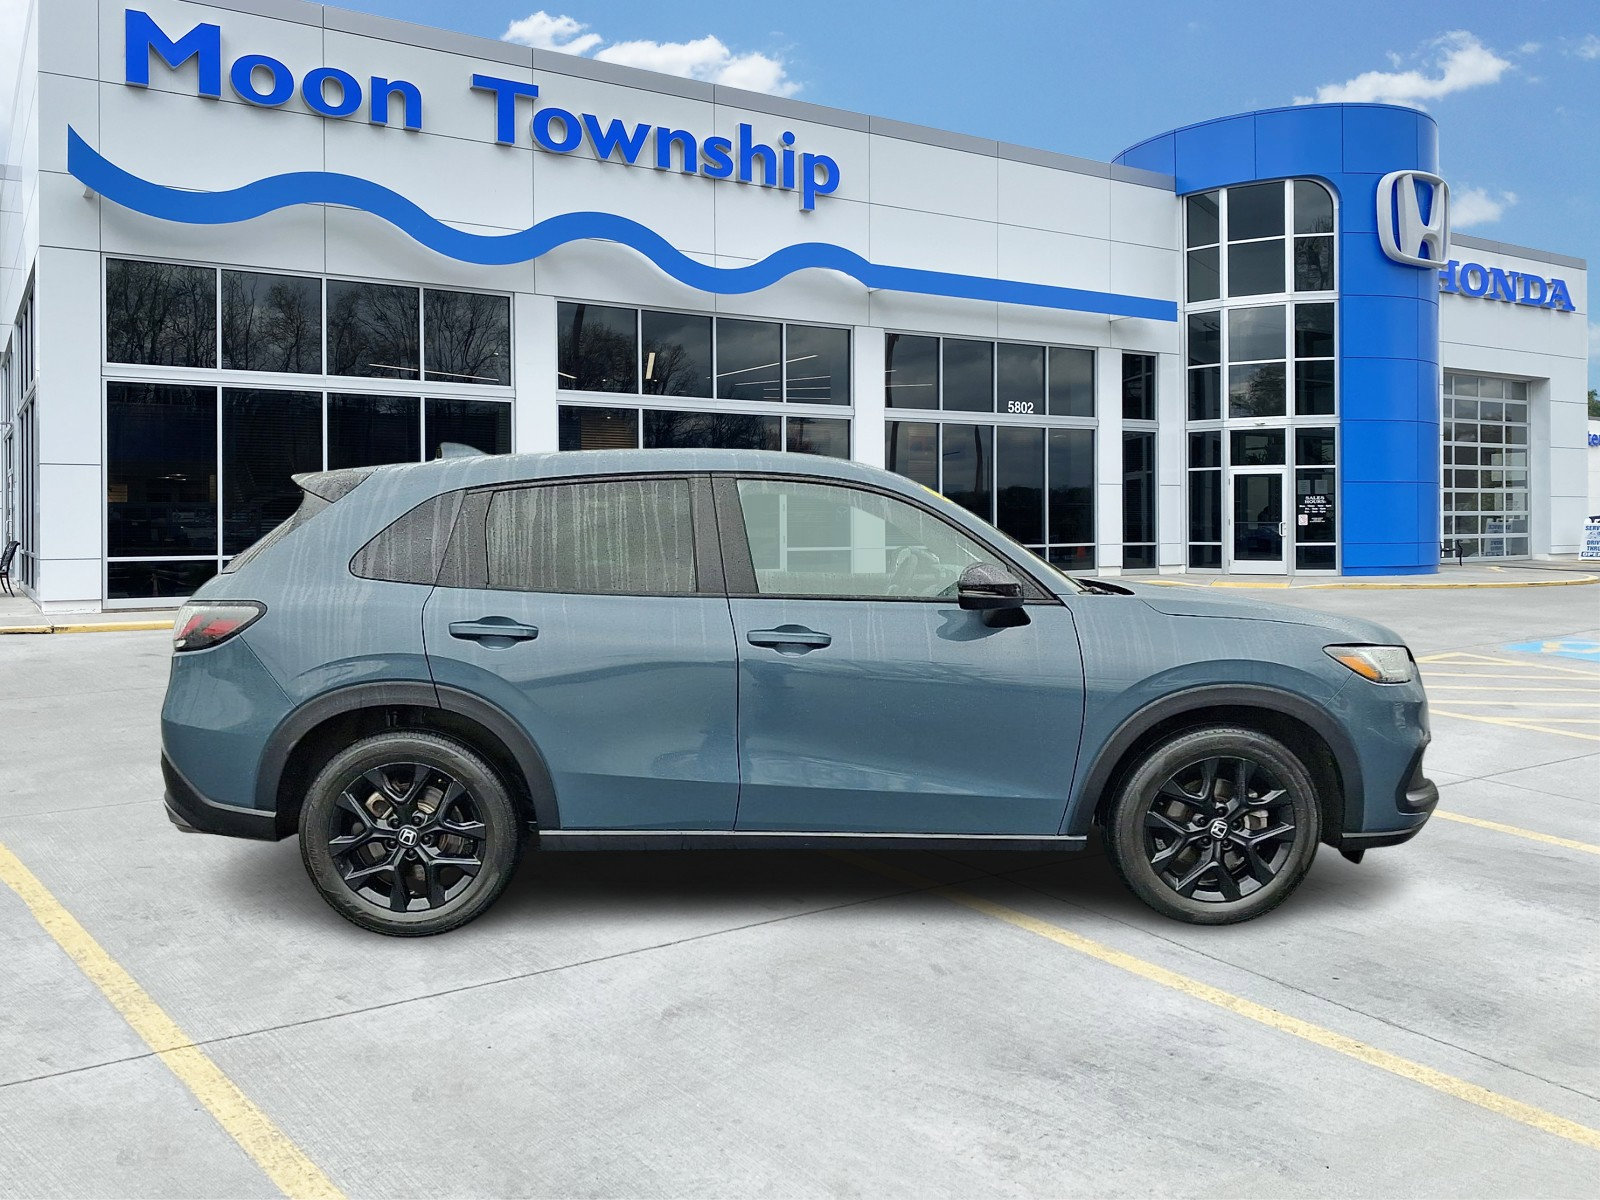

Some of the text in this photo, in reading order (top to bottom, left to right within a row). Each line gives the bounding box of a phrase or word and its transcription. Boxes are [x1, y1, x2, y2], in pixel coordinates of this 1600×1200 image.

[125, 8, 841, 212] Moon Township
[1438, 259, 1576, 312] HONDA
[1007, 400, 1035, 414] 5802
